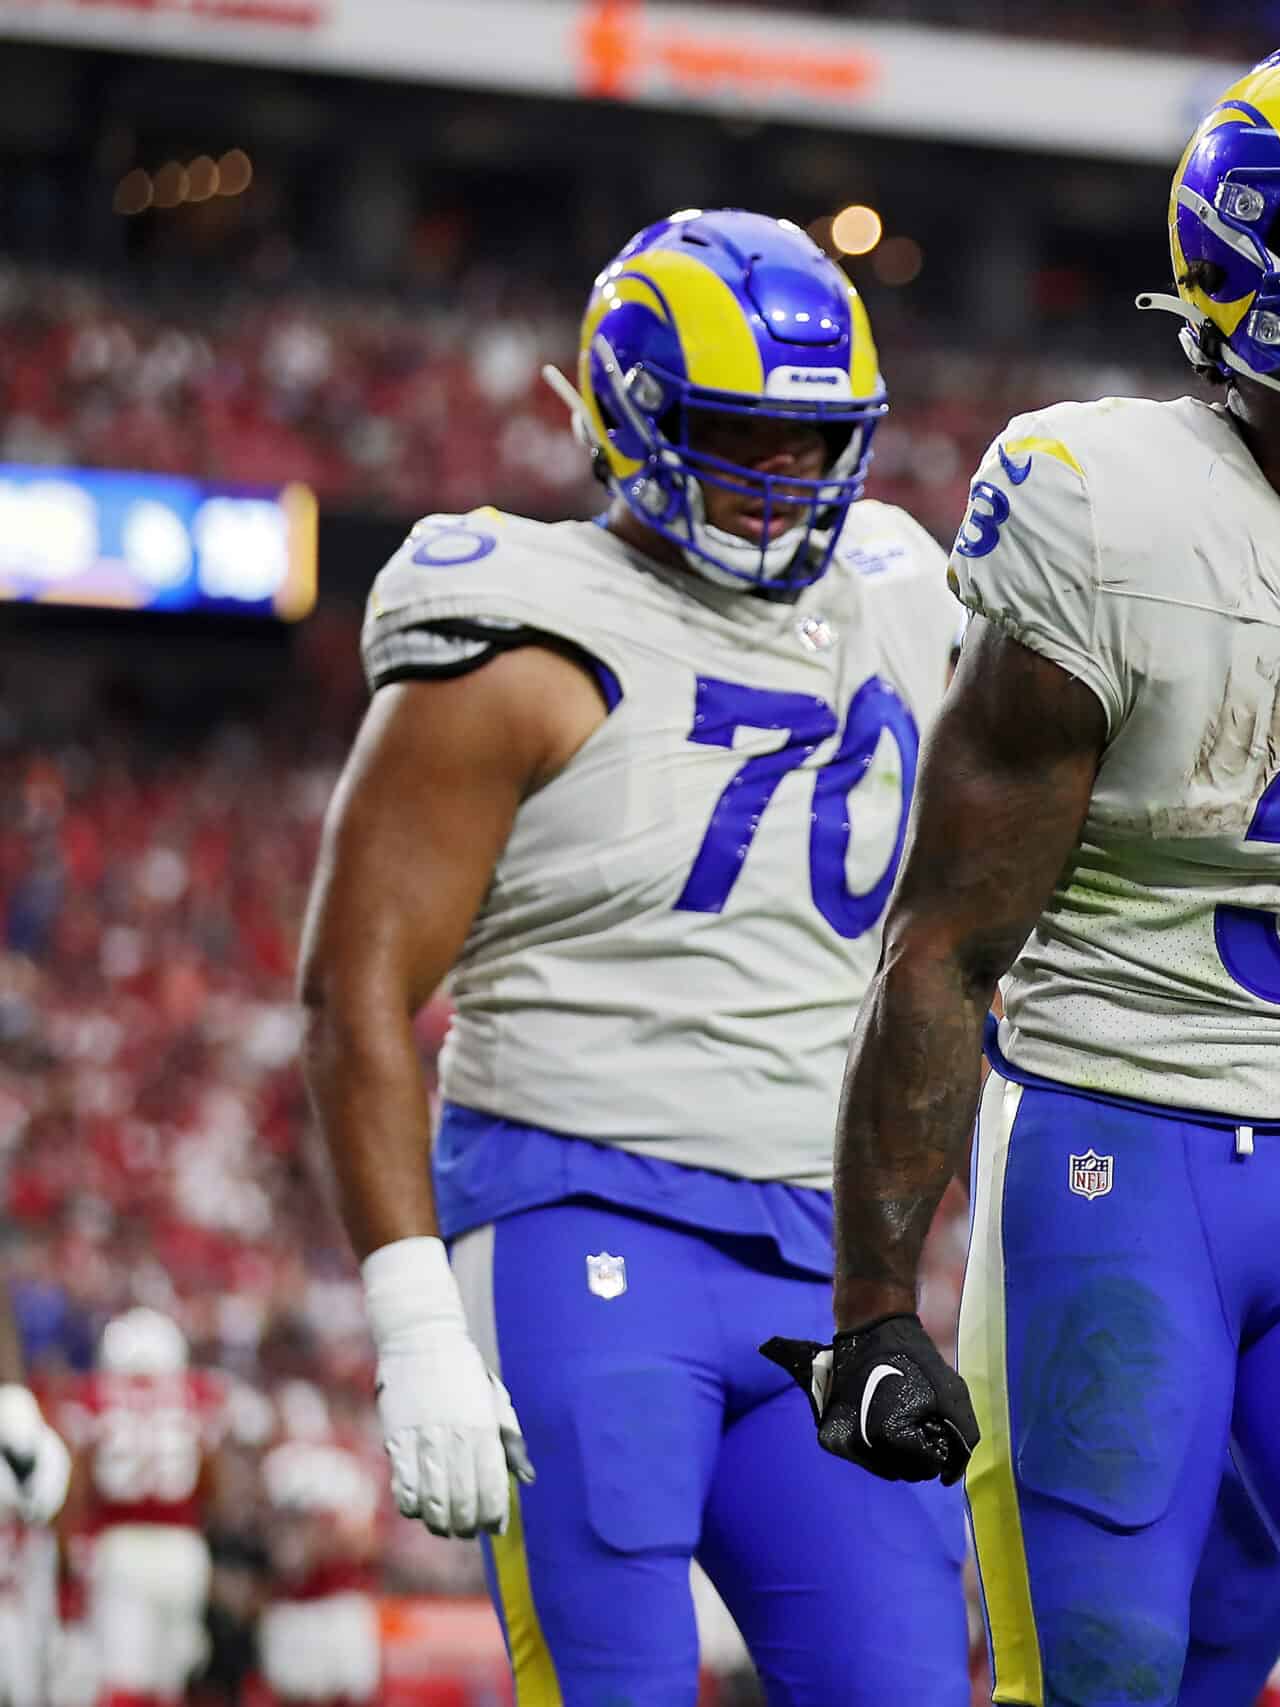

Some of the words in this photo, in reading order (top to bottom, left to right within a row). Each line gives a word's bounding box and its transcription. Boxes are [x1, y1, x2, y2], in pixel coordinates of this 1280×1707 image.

[956, 481, 1010, 558] 3
[672, 674, 920, 939] 70
[1076, 1172, 1105, 1191] NFL
